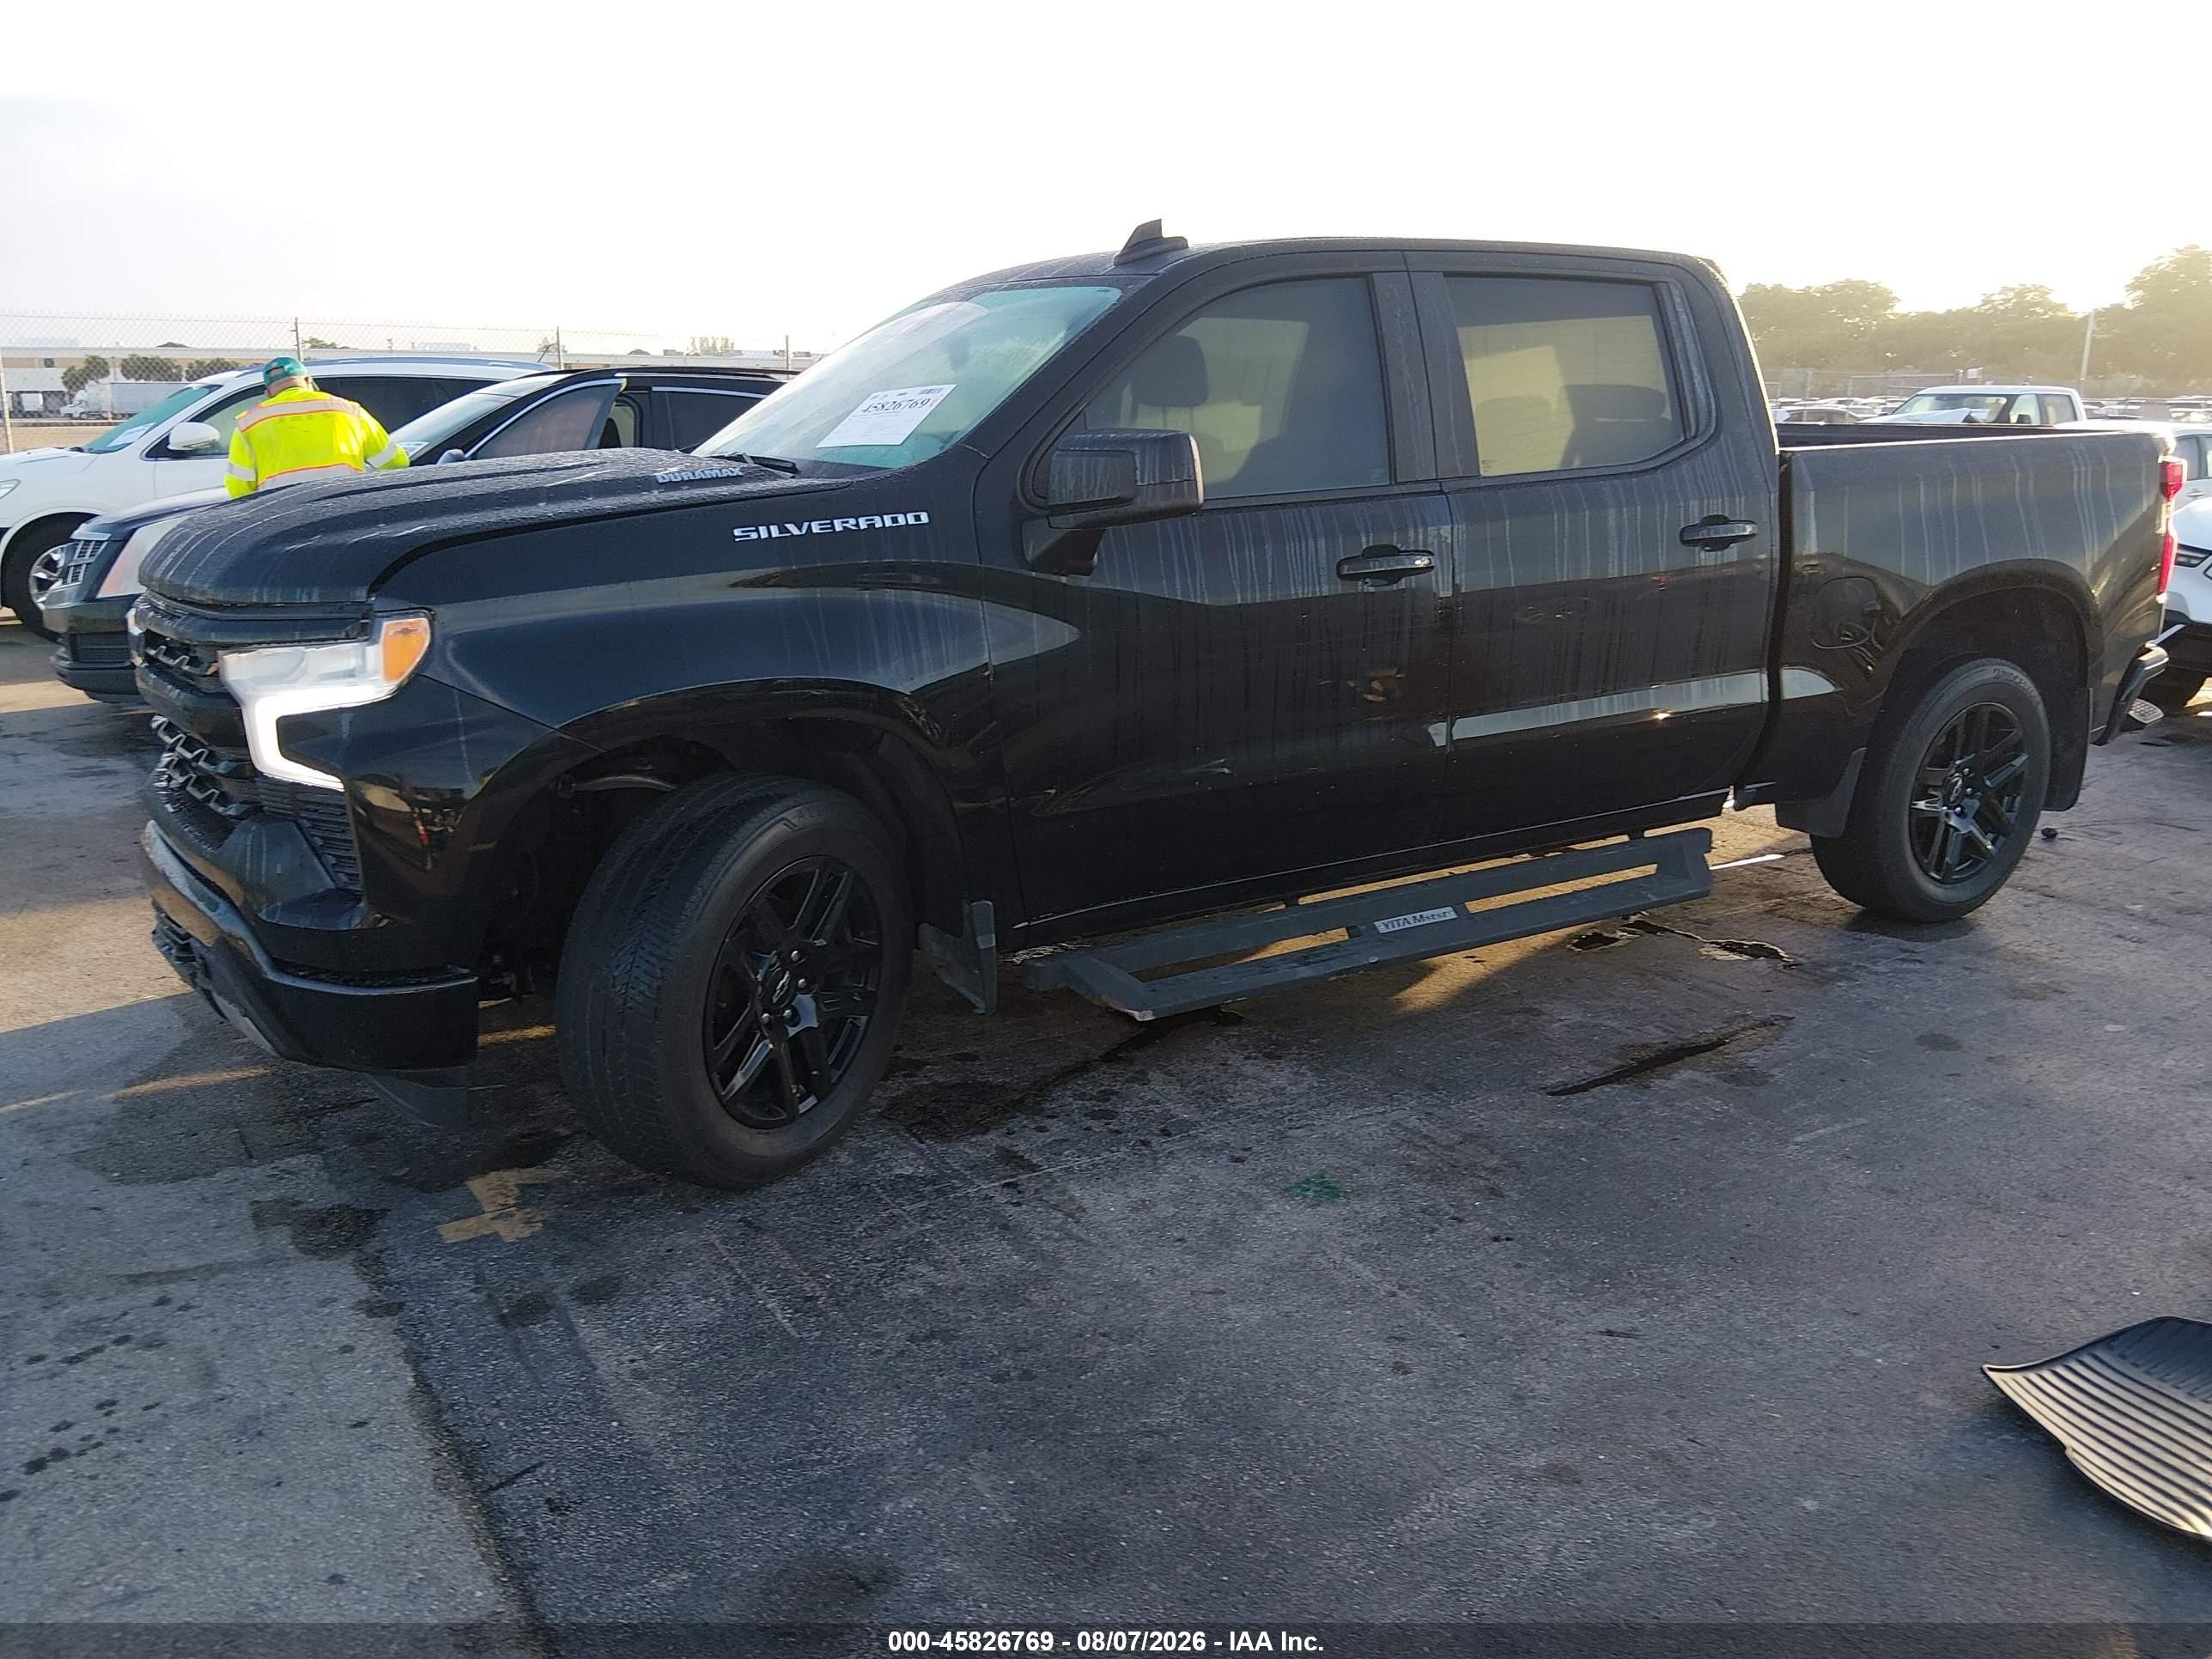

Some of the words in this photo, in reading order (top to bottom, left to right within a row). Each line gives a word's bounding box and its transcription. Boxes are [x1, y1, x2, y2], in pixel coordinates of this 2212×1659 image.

[861, 398, 931, 413] 45826769
[655, 466, 744, 483] DURAMAX
[732, 511, 930, 542] SILVERADO
